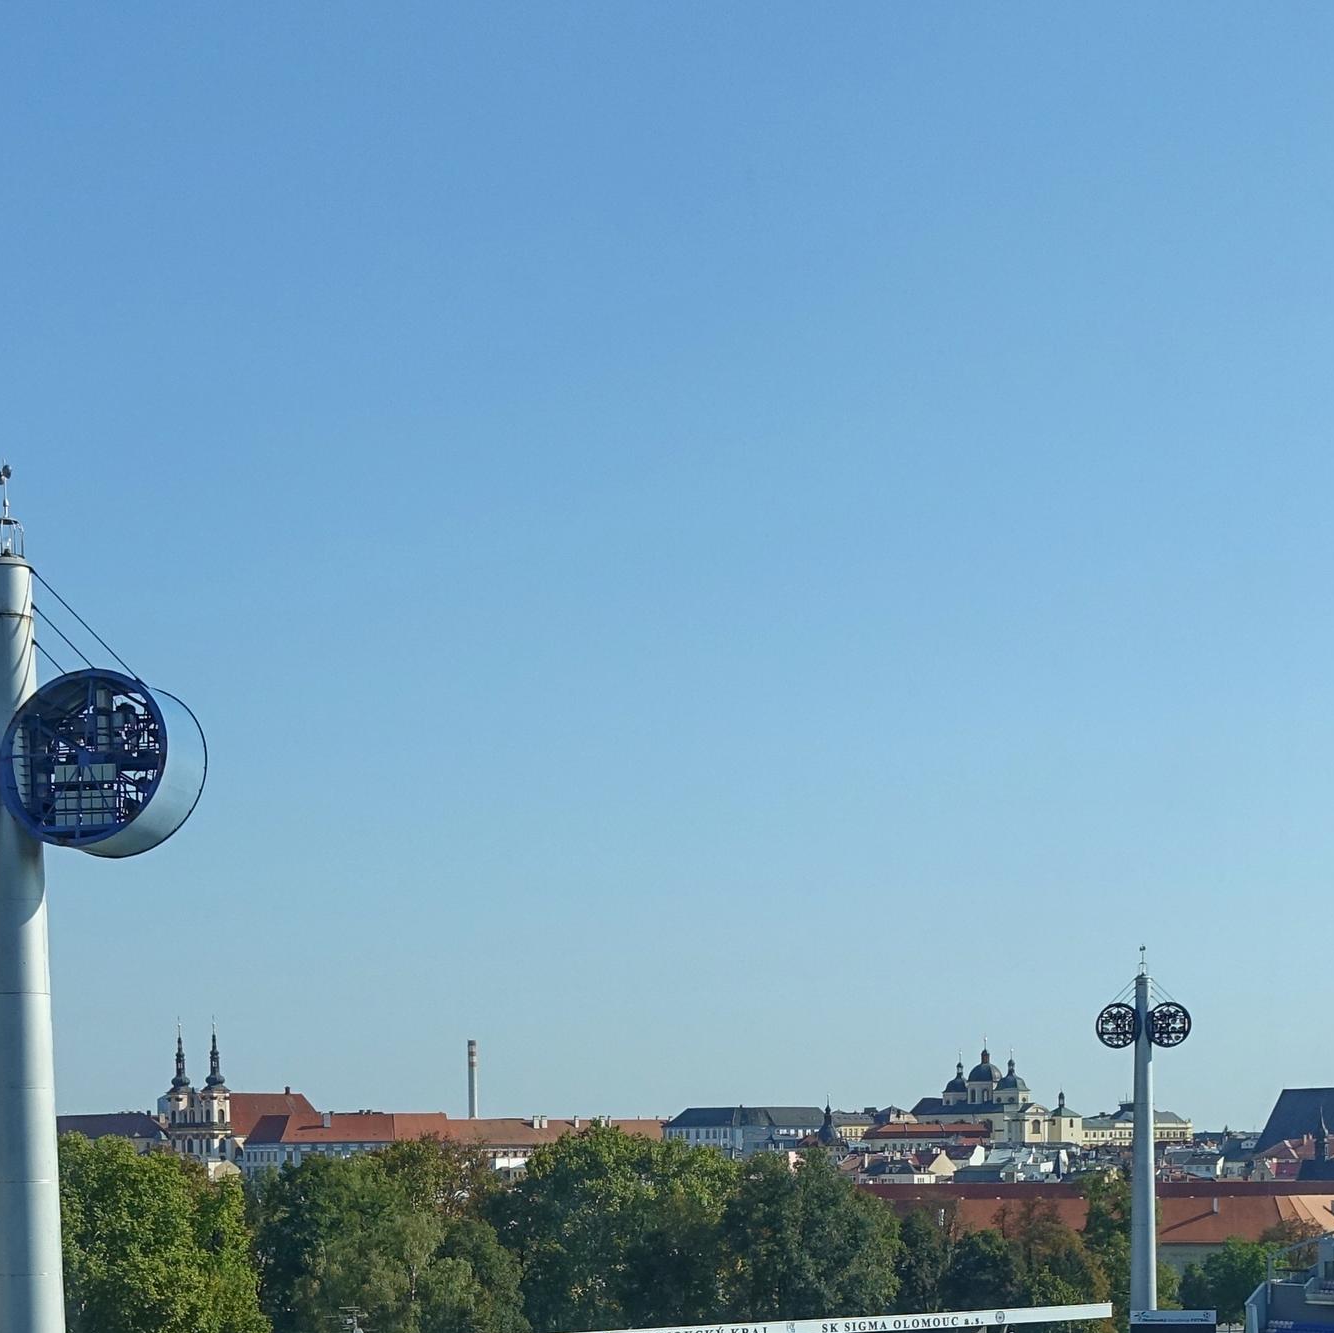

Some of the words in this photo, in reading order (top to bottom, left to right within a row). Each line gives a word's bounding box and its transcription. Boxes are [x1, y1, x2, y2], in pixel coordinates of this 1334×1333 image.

[821, 1322, 840, 1333] SK
[844, 1319, 888, 1332] SIGMA
[892, 1316, 959, 1330] OLOMOUC
[964, 1315, 984, 1325] a.s.
